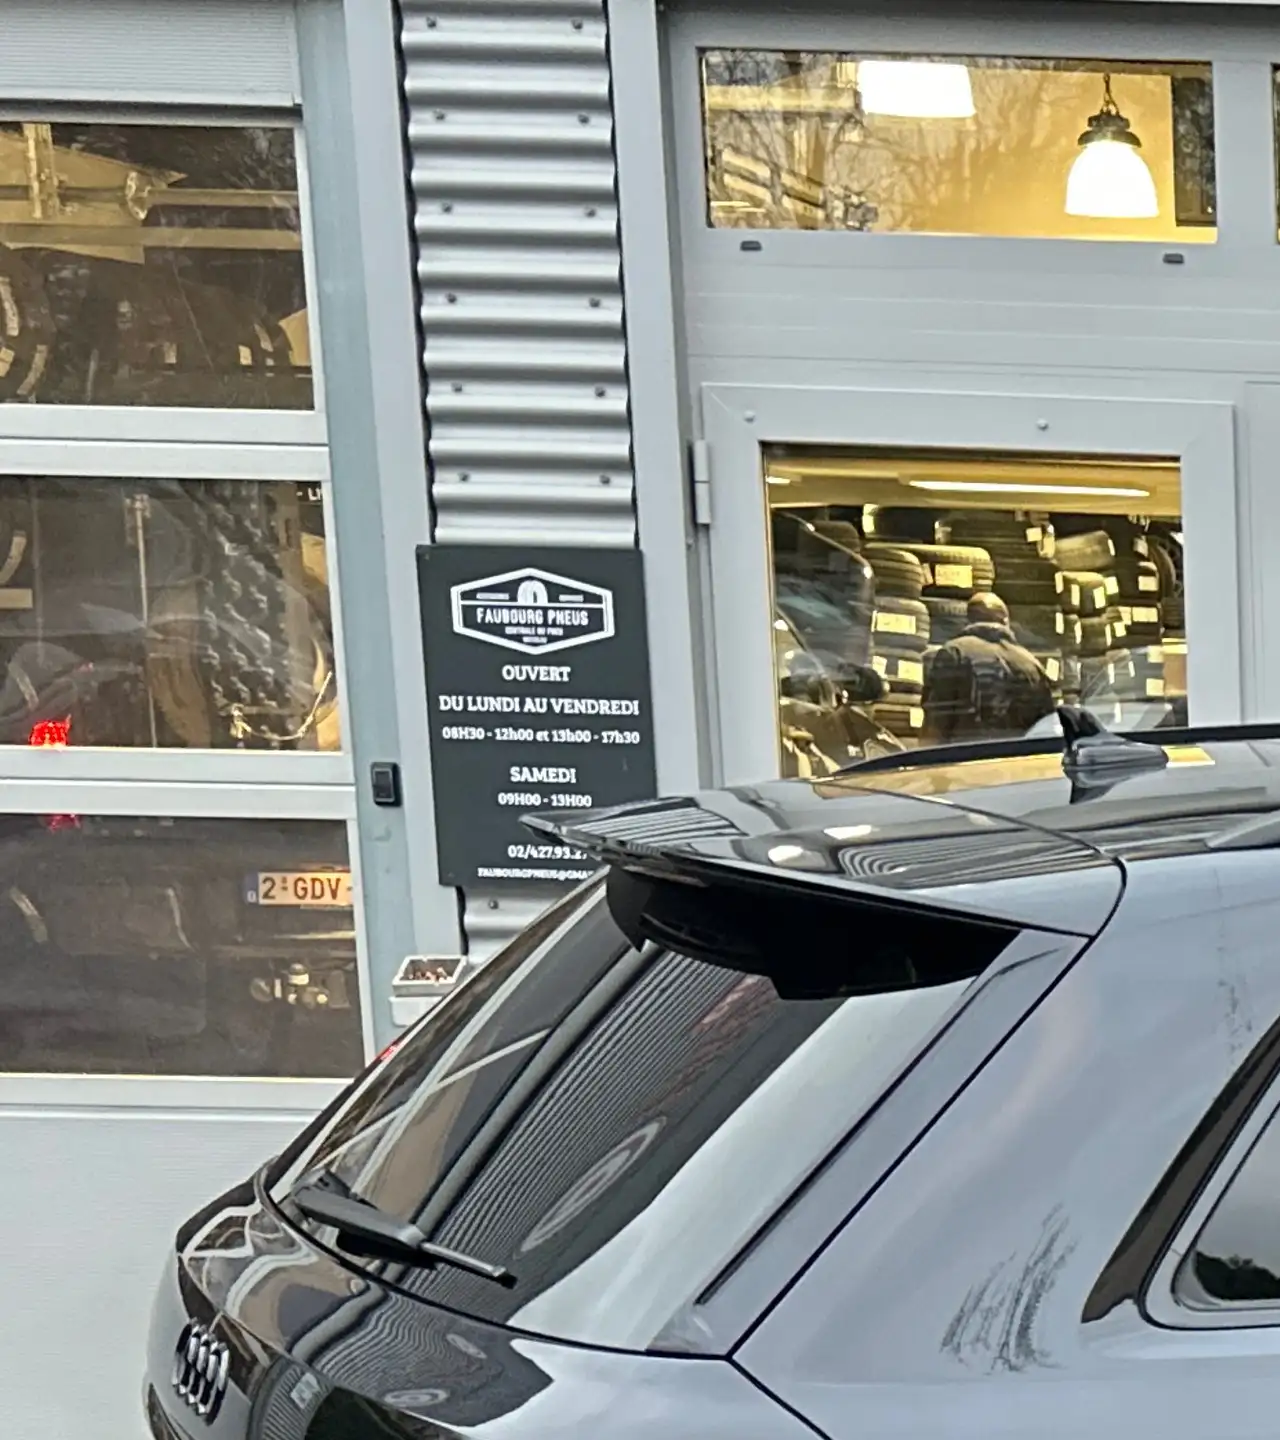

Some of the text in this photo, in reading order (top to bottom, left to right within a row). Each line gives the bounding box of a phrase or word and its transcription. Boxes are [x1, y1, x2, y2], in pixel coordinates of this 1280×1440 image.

[476, 607, 589, 626] FAUBOURG PNEUS
[501, 664, 572, 682] OUVERT
[438, 695, 640, 716] DU LUNDI AU VENDREDI
[442, 726, 485, 740] 08H30
[494, 727, 535, 742] 12h00
[535, 729, 550, 742] et
[551, 729, 592, 743] 13h00
[601, 730, 641, 745] 17h30
[509, 766, 577, 784] SAMEDI
[497, 791, 542, 806] 09H00
[550, 793, 593, 808] 13H00
